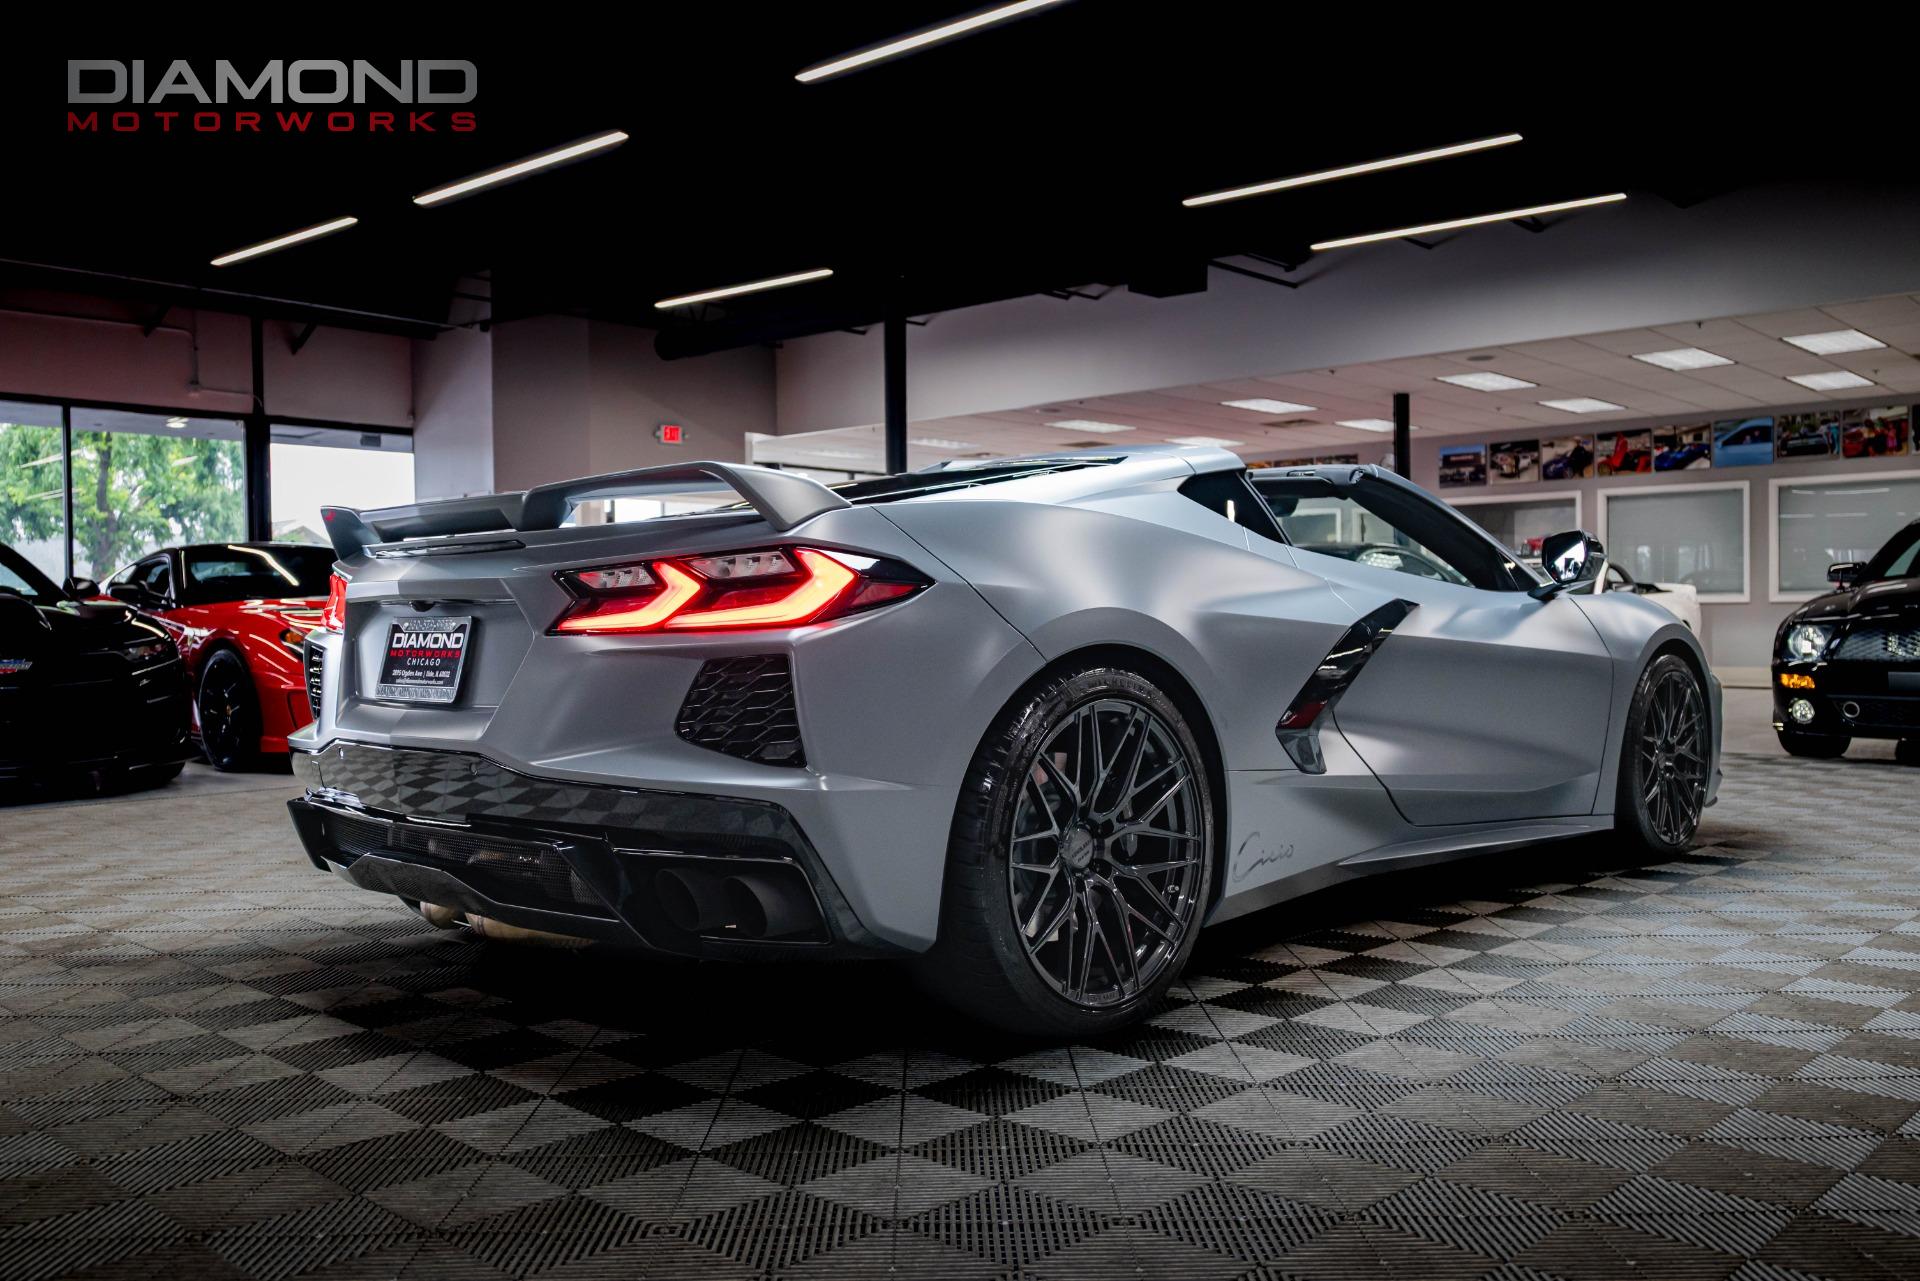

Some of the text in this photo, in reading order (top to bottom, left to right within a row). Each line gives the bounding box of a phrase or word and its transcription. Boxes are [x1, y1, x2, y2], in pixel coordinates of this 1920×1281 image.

[392, 633, 464, 648] DIAMOND
[390, 650, 461, 658] MOTORWORKS
[407, 658, 441, 666] CHICAGO
